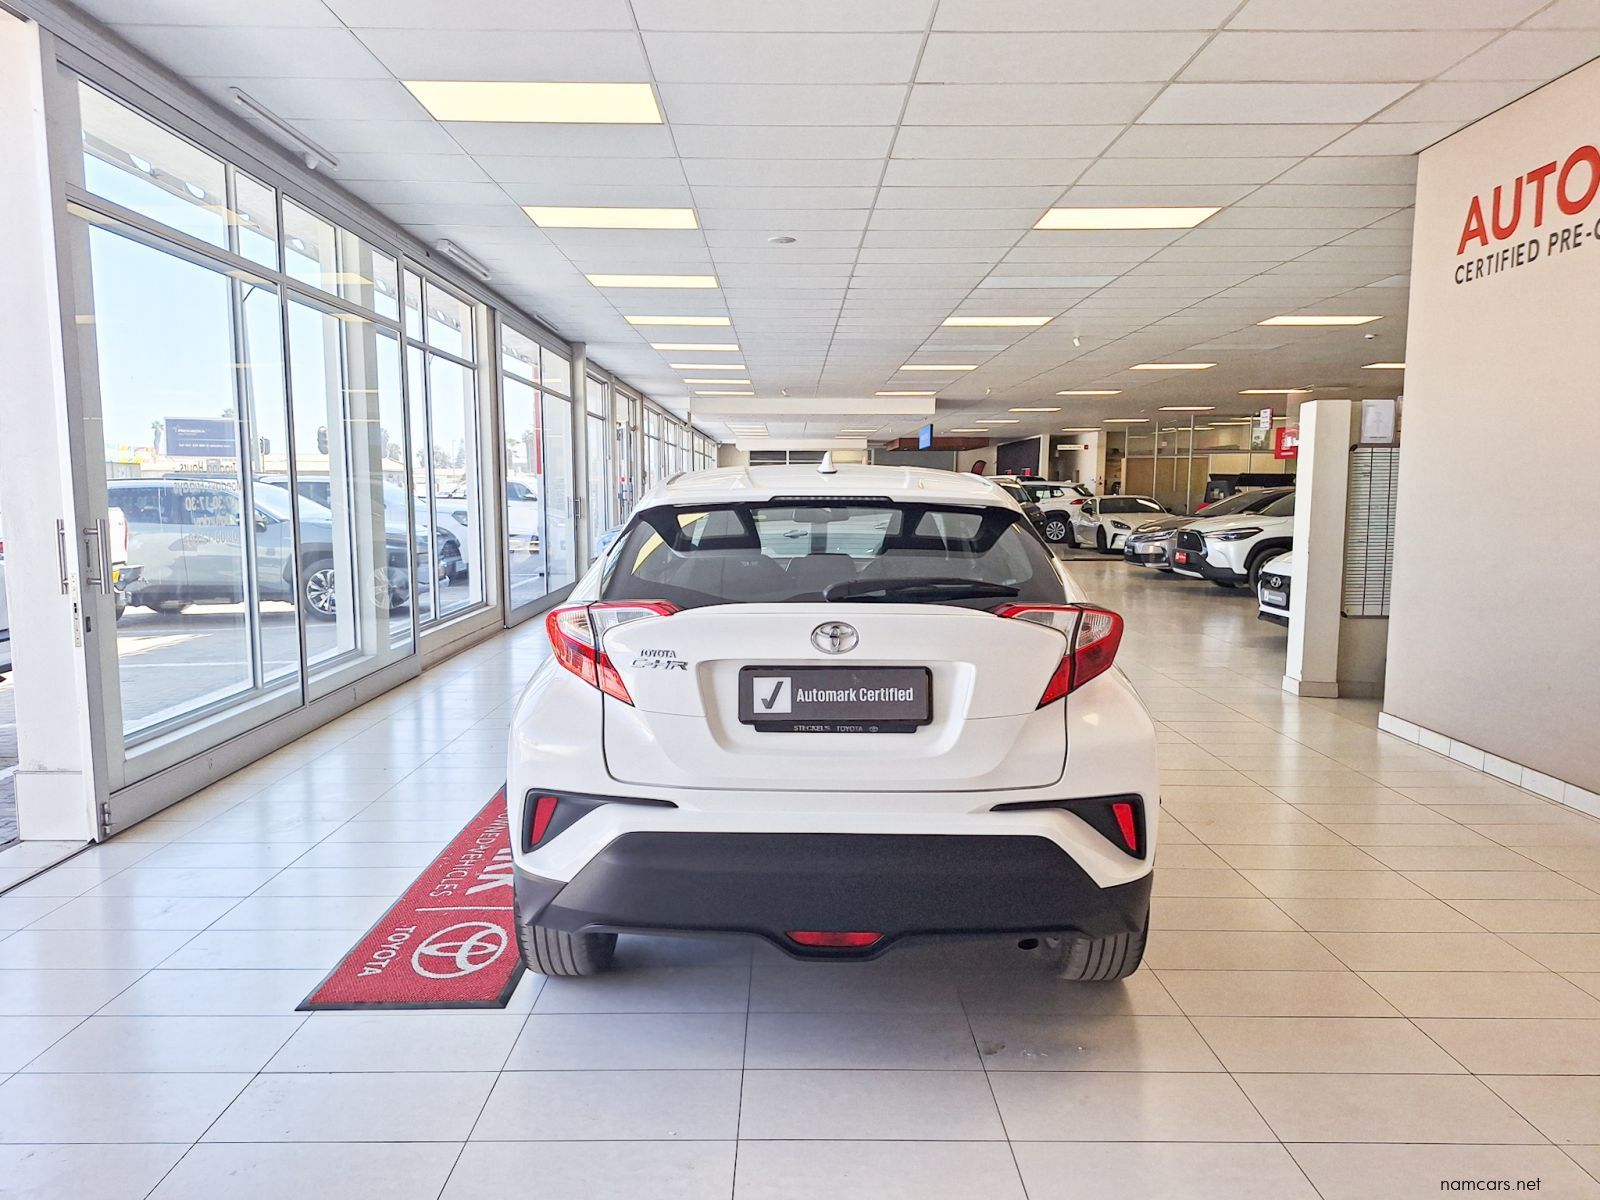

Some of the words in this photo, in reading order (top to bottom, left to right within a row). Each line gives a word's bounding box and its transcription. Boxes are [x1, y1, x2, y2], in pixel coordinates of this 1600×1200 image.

[1456, 145, 1600, 256] AUTO
[1454, 238, 1540, 285] CERTIFIED
[631, 658, 688, 671] C-HR
[640, 649, 677, 659] TOYOTA
[796, 686, 857, 703] Automark
[859, 686, 914, 703] Certified
[836, 724, 864, 732] TOYOTA
[429, 845, 492, 897] VEHICLES
[357, 924, 417, 977] TOYOTA
